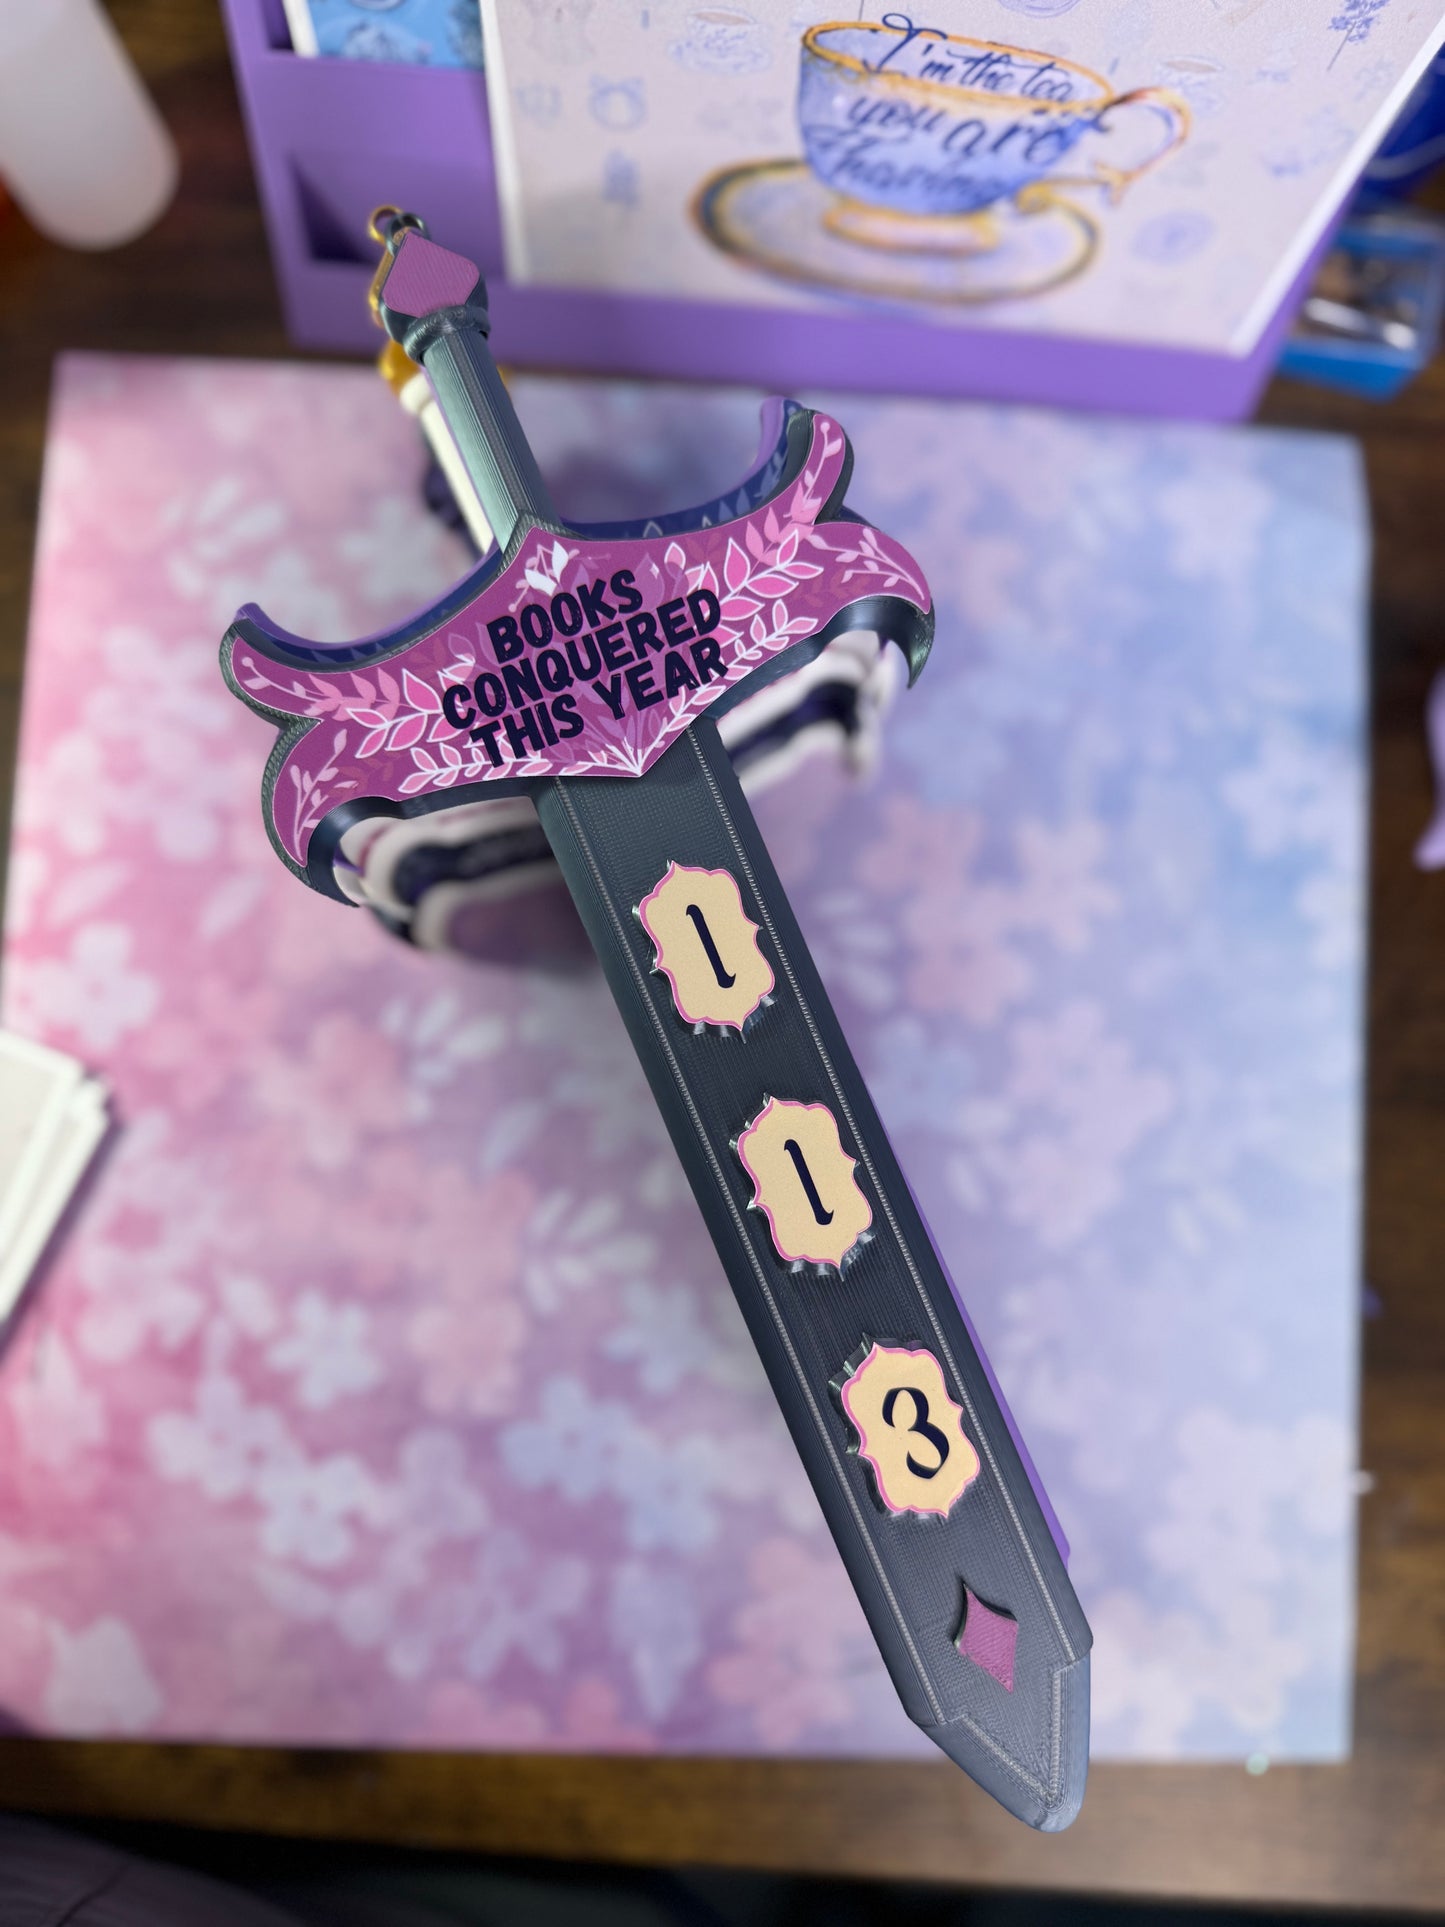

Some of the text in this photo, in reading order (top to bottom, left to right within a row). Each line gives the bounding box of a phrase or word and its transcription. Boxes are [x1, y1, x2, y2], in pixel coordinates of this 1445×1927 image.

[862, 13, 1075, 104] I'm the tea
[943, 119, 1067, 166] are
[442, 588, 722, 730] CONQUERED
[486, 570, 644, 664] BOOKS
[470, 637, 729, 768] THIS YEAR
[685, 904, 736, 988] 1
[783, 1138, 834, 1226] 1
[881, 1386, 950, 1480] 3
